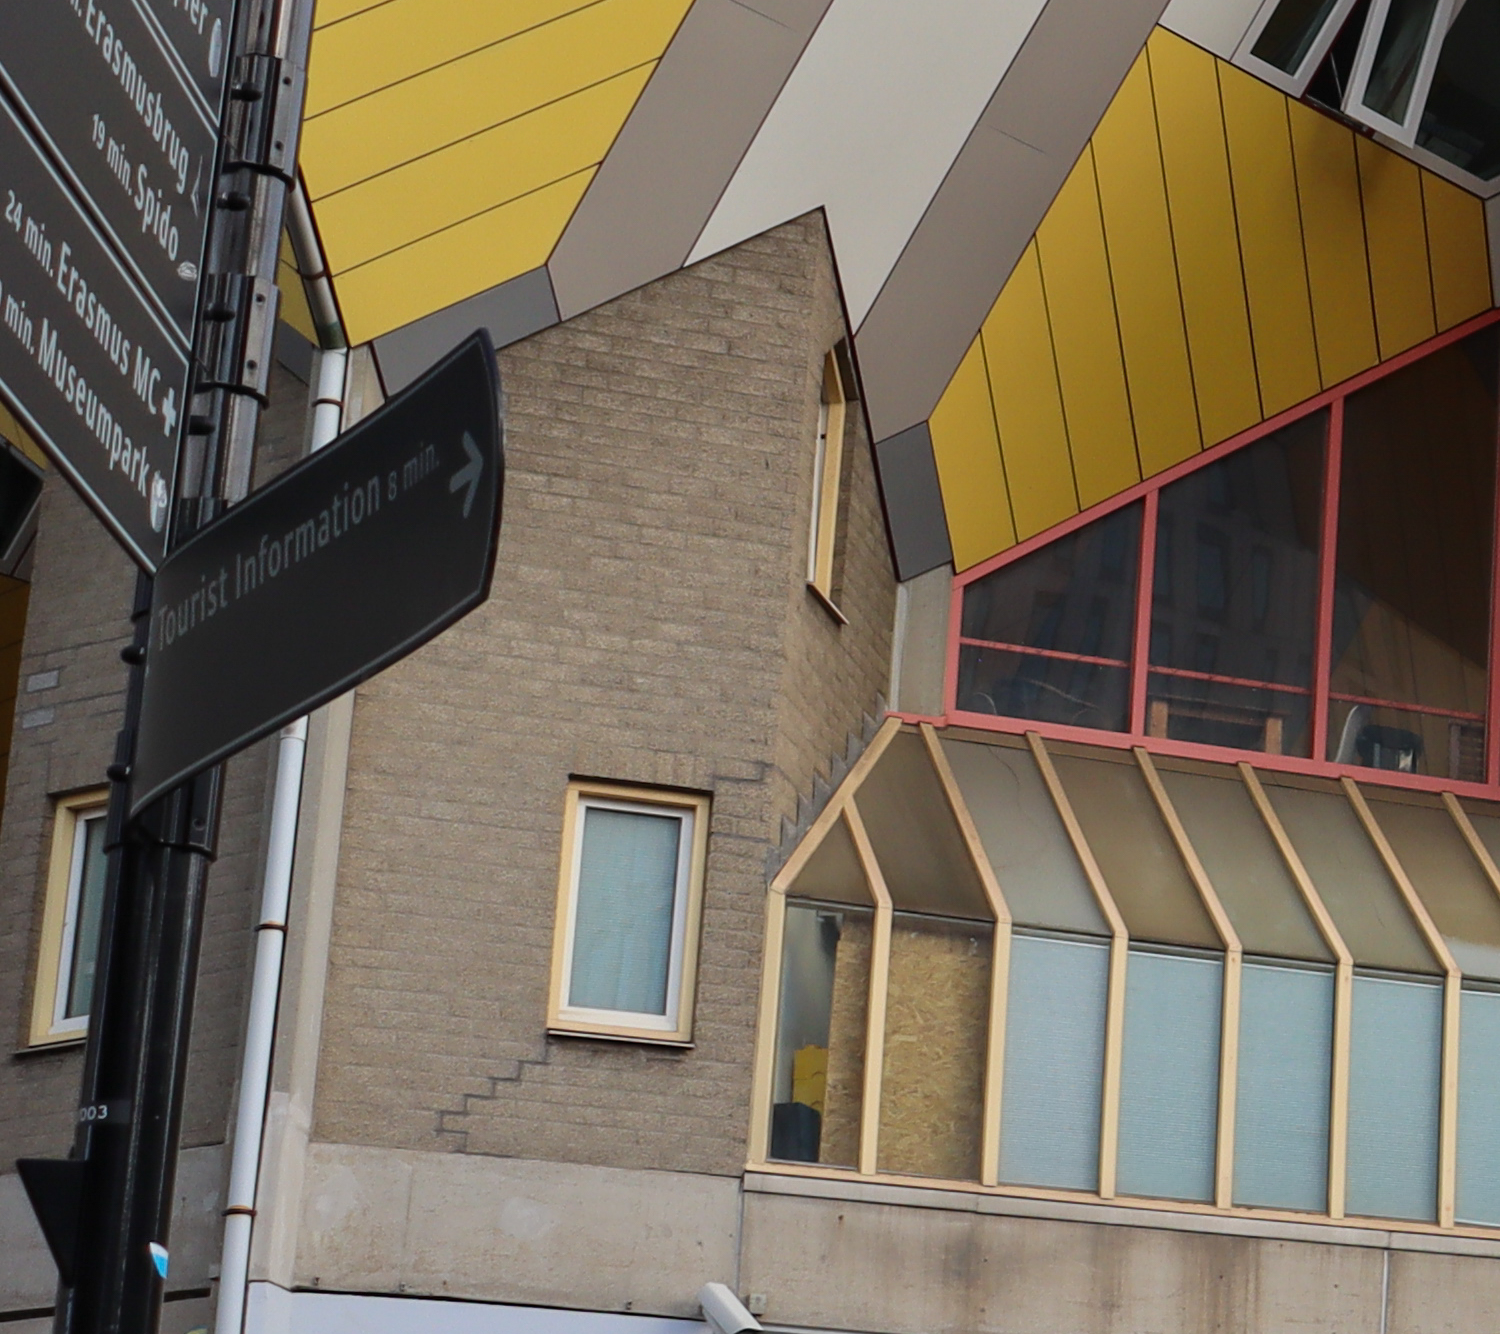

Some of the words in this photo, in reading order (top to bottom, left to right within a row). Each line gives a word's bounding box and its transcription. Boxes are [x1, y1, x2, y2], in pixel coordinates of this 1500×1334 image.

[91, 112, 106, 150] 19
[106, 136, 133, 197] min.
[134, 163, 180, 262] Spido
[4, 293, 35, 356] min.
[38, 316, 151, 497] Museumpark
[5, 189, 23, 233] 24
[24, 215, 54, 278] min.
[56, 240, 131, 376] Erasmus
[133, 344, 161, 416] MC
[157, 568, 228, 652] Tourist
[235, 481, 381, 600] Information
[387, 470, 397, 502] 8
[403, 440, 441, 491] min.
